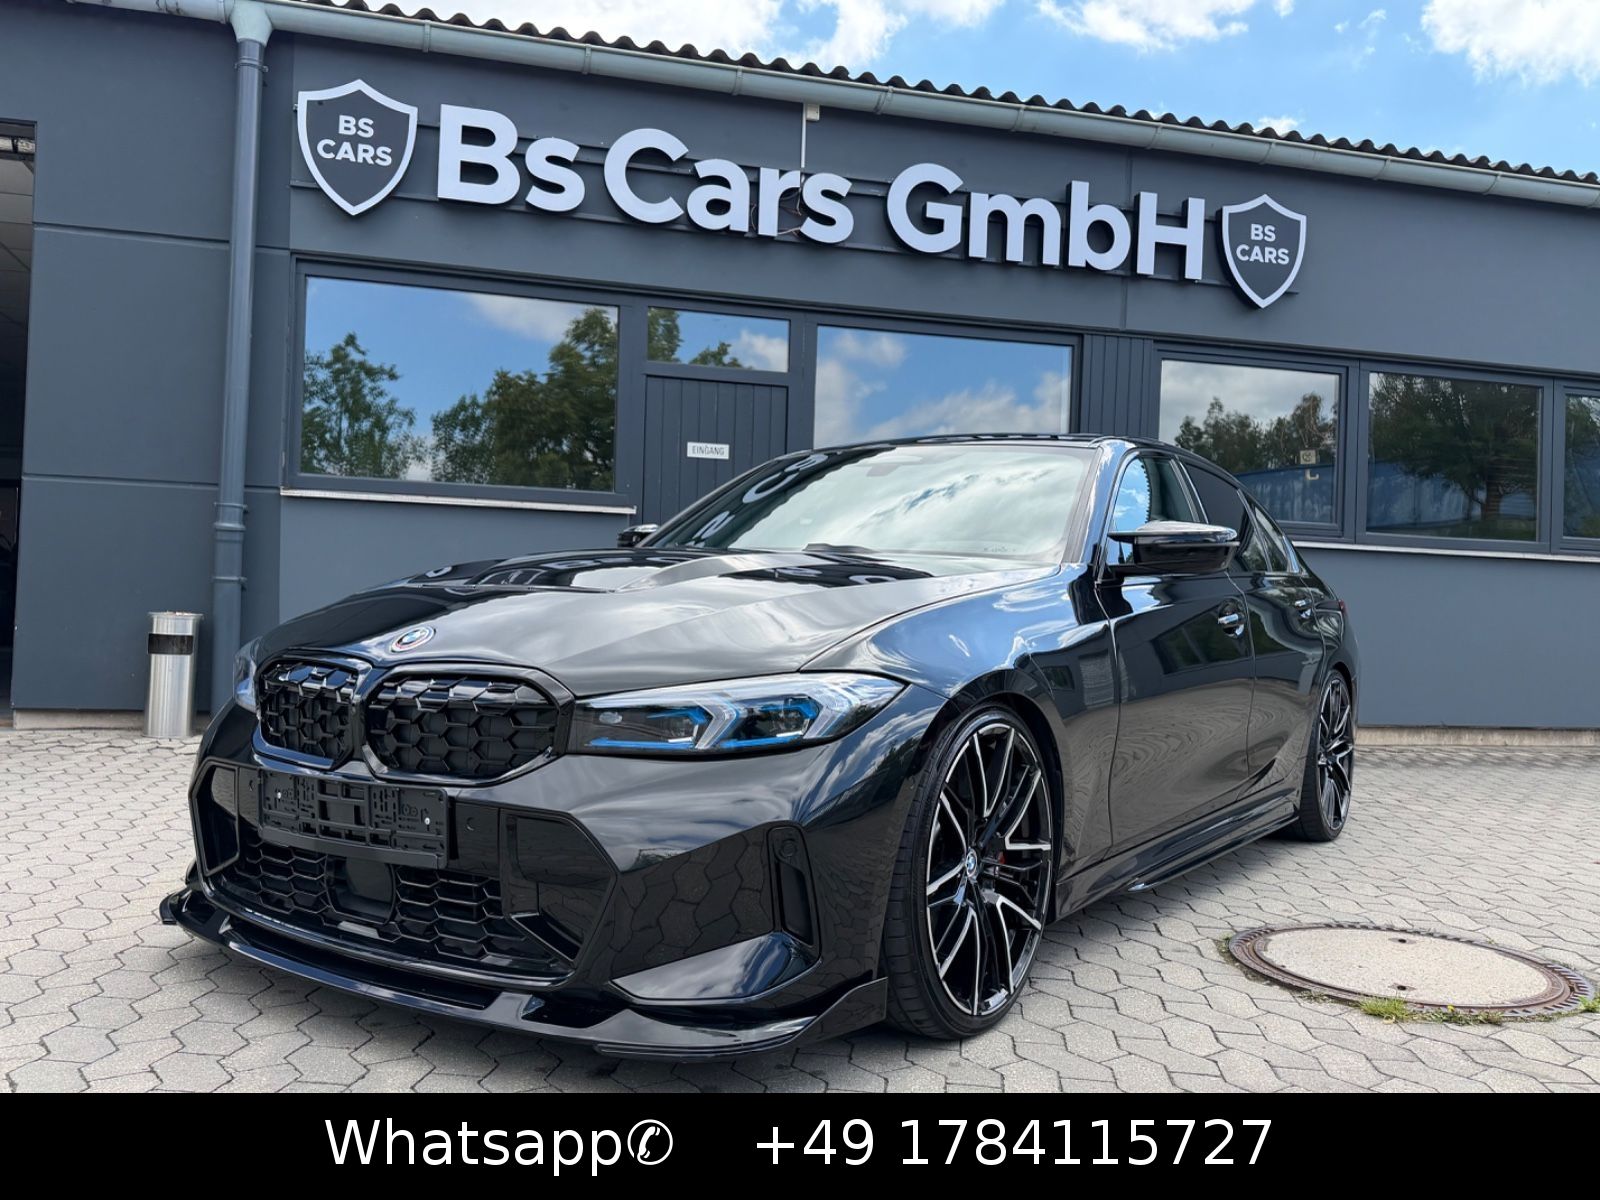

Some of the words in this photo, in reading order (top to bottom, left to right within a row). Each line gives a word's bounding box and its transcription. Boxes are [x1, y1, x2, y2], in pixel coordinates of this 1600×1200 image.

[338, 114, 375, 138] BS
[316, 138, 393, 167] CARS
[437, 104, 586, 212] Bs
[603, 127, 855, 243] Cars
[887, 162, 1206, 281] GmbH
[1250, 223, 1276, 242] BS
[1235, 244, 1290, 265] CARS
[691, 445, 725, 456] EINGANG
